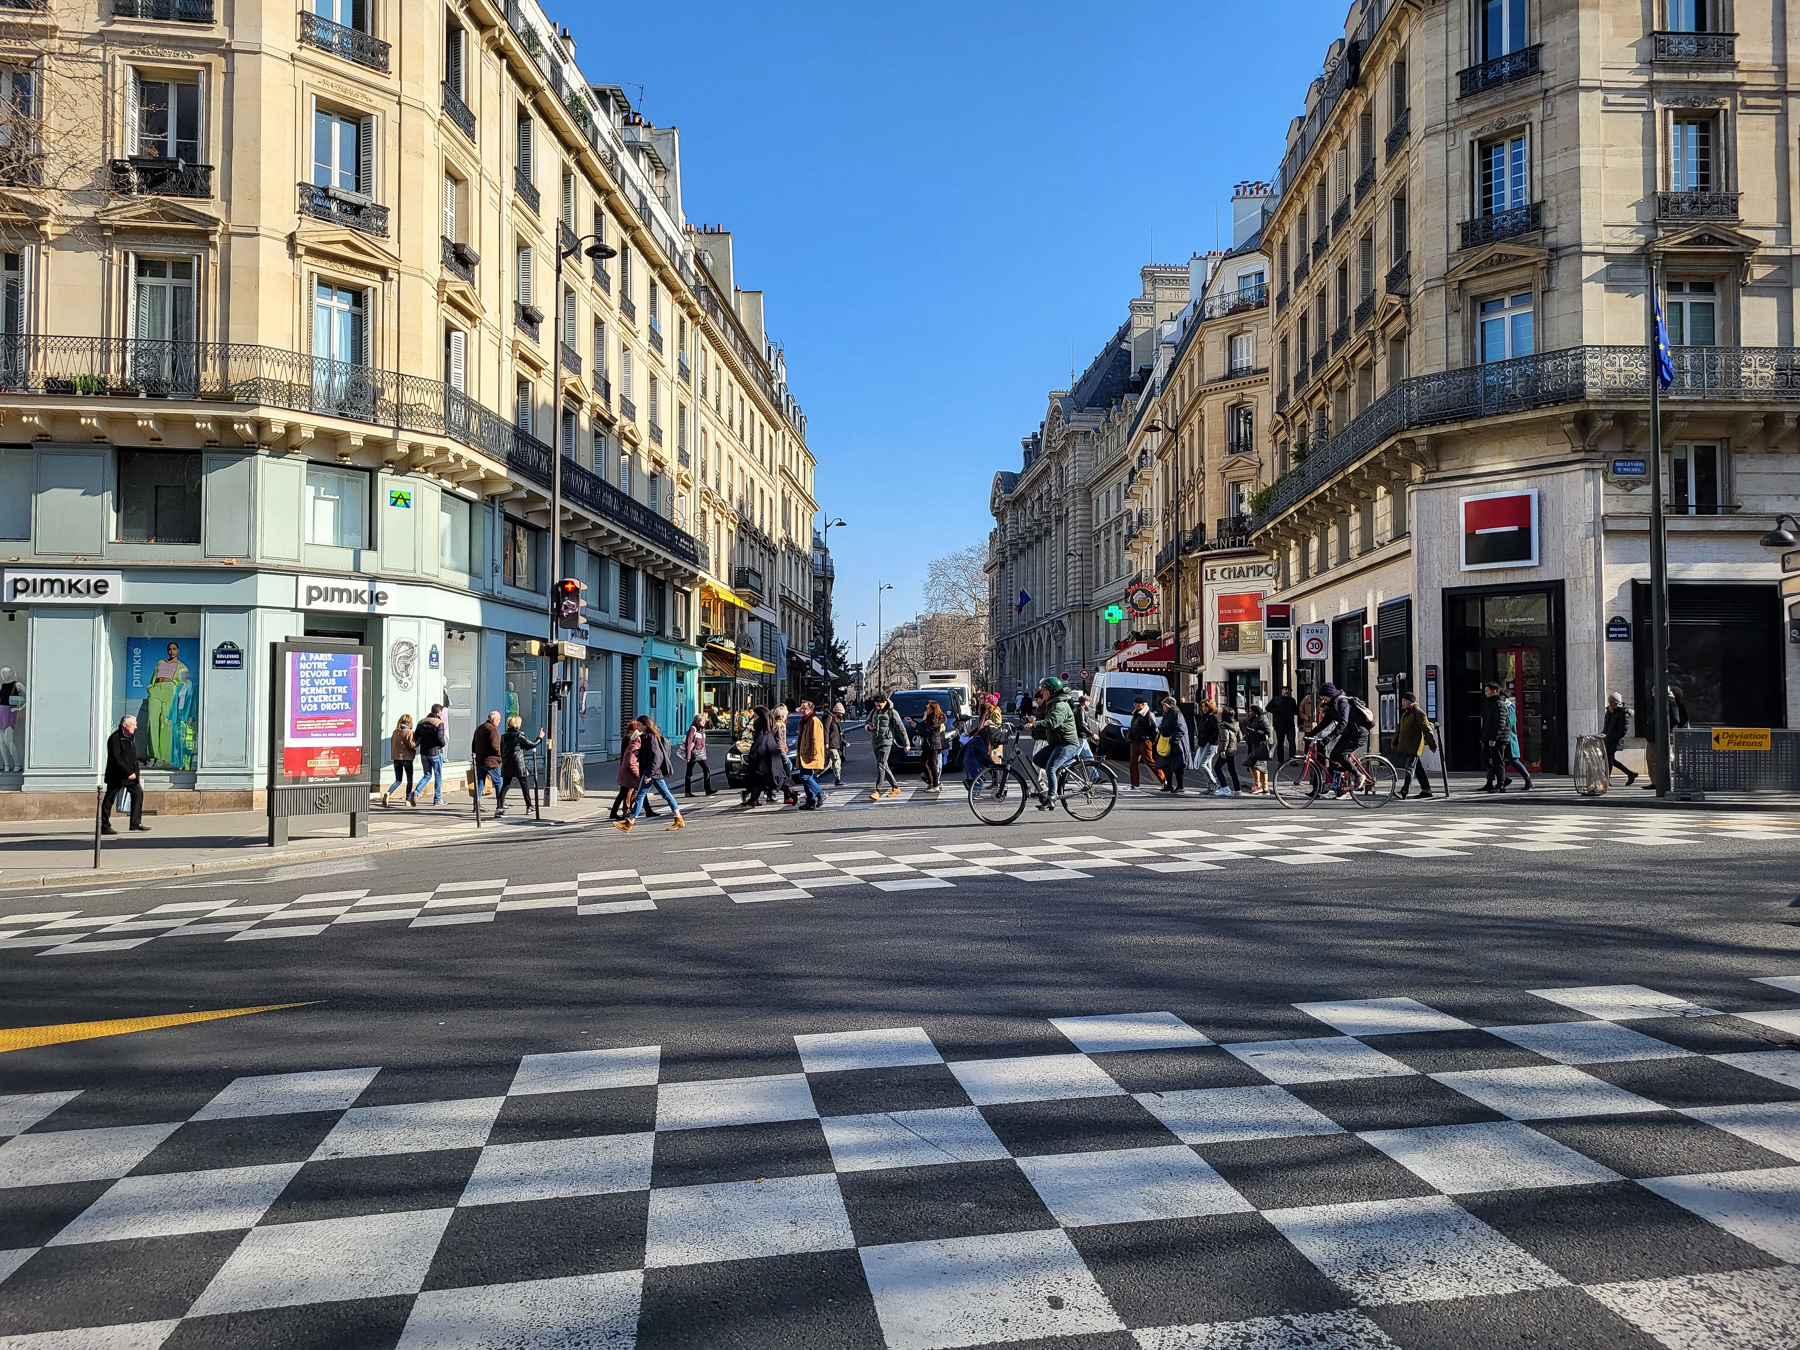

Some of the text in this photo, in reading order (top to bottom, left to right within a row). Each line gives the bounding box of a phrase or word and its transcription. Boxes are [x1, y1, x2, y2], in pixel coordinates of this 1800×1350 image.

[1205, 568, 1217, 582] LE
[13, 577, 110, 599] pimkie
[306, 585, 389, 606] pimkie
[1309, 642, 1320, 650] 30
[132, 647, 144, 688] pimkie
[299, 661, 328, 670] NOTRE
[299, 669, 348, 679] DEVOIR EST
[300, 678, 337, 687] DE VOUS
[300, 686, 349, 695] PERMETTRE
[300, 694, 343, 703] D'EXERCER
[301, 702, 352, 712] VOS DROITS.
[1721, 731, 1768, 740] Déviation
[1727, 739, 1763, 747] Piétons
